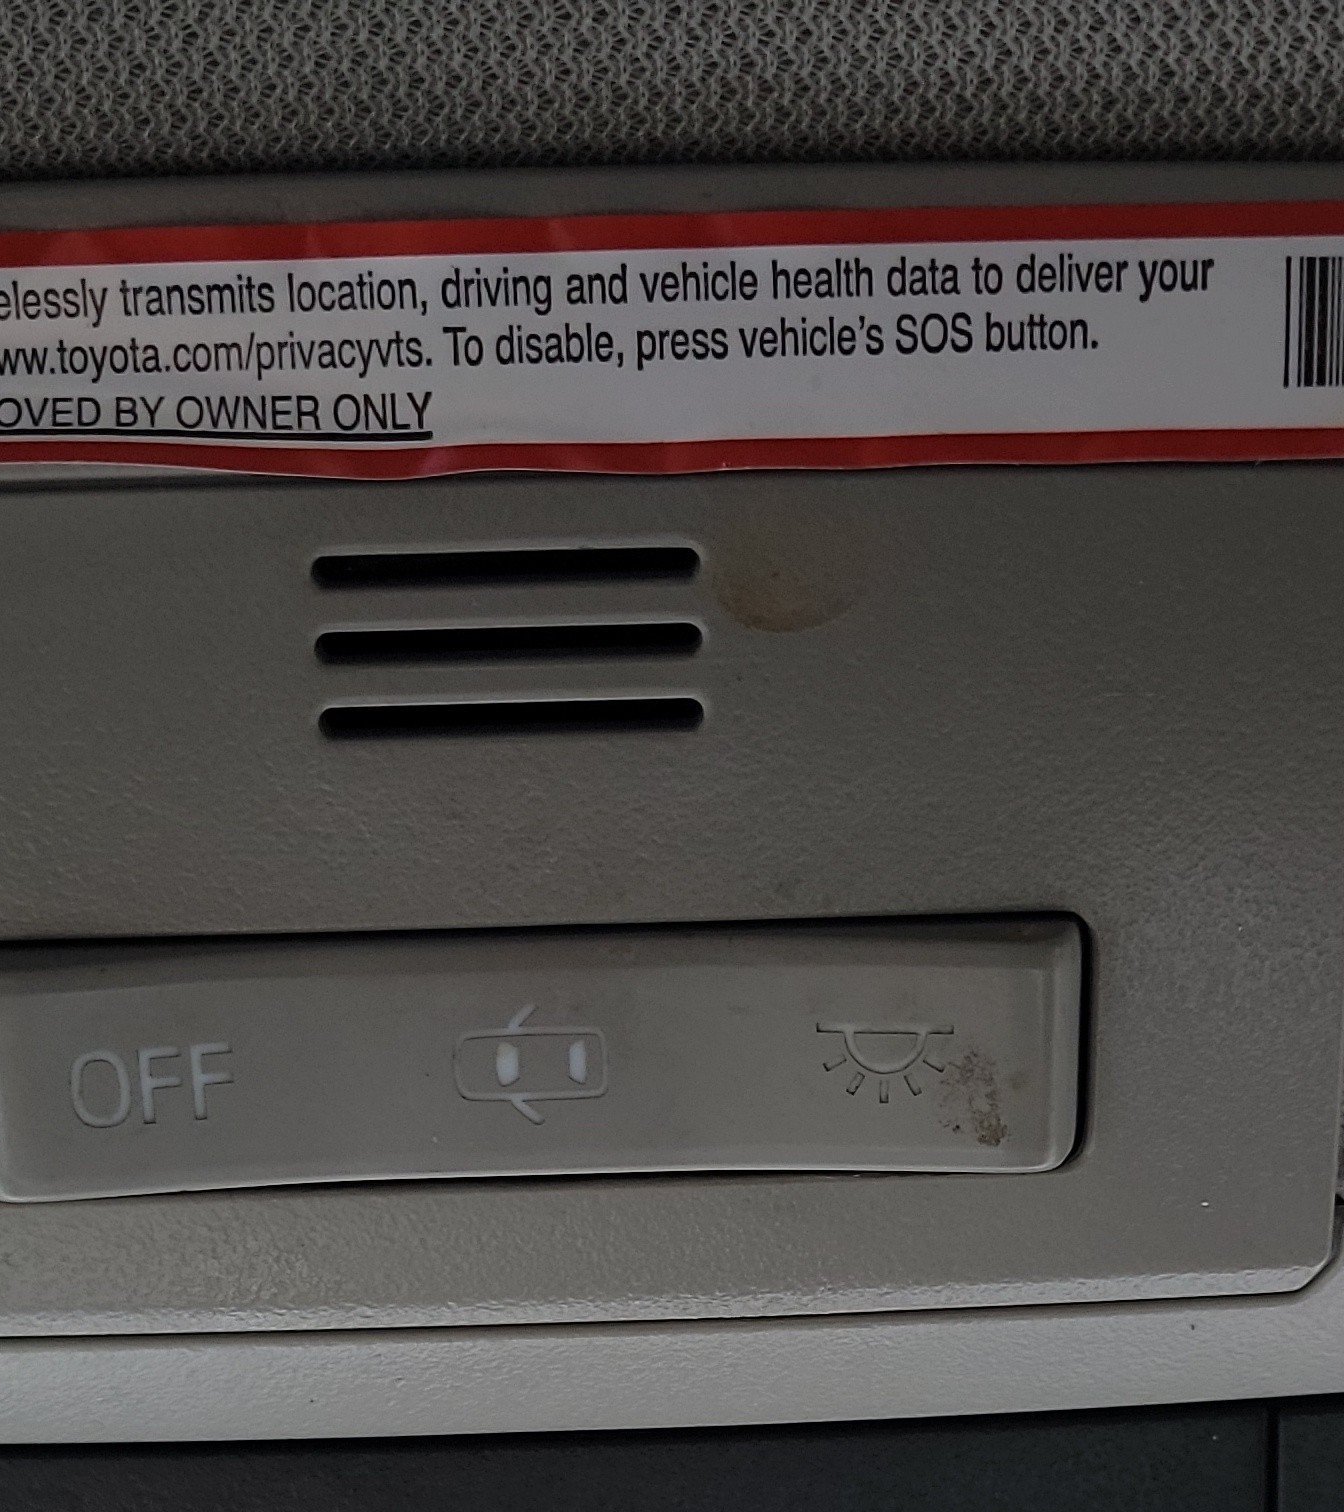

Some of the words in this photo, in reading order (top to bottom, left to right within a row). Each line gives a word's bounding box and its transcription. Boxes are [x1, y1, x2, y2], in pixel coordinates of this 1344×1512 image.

[118, 273, 275, 317] transmits
[286, 271, 429, 317] location,
[441, 267, 552, 314] driving
[566, 265, 628, 305] and
[641, 261, 757, 303] vehicle
[771, 258, 874, 300] health
[887, 256, 960, 297] data
[972, 258, 1003, 295] to
[1016, 254, 1127, 294] deliver
[1138, 258, 1215, 302] your
[443, 328, 483, 367] To
[494, 322, 625, 367] disable,
[636, 327, 727, 370] press
[895, 314, 974, 355] SOS
[985, 312, 1099, 352] button.
[114, 395, 164, 429] BY
[177, 395, 322, 430] OWNER
[332, 391, 433, 431] ONLY
[69, 1041, 236, 1130] OFF
